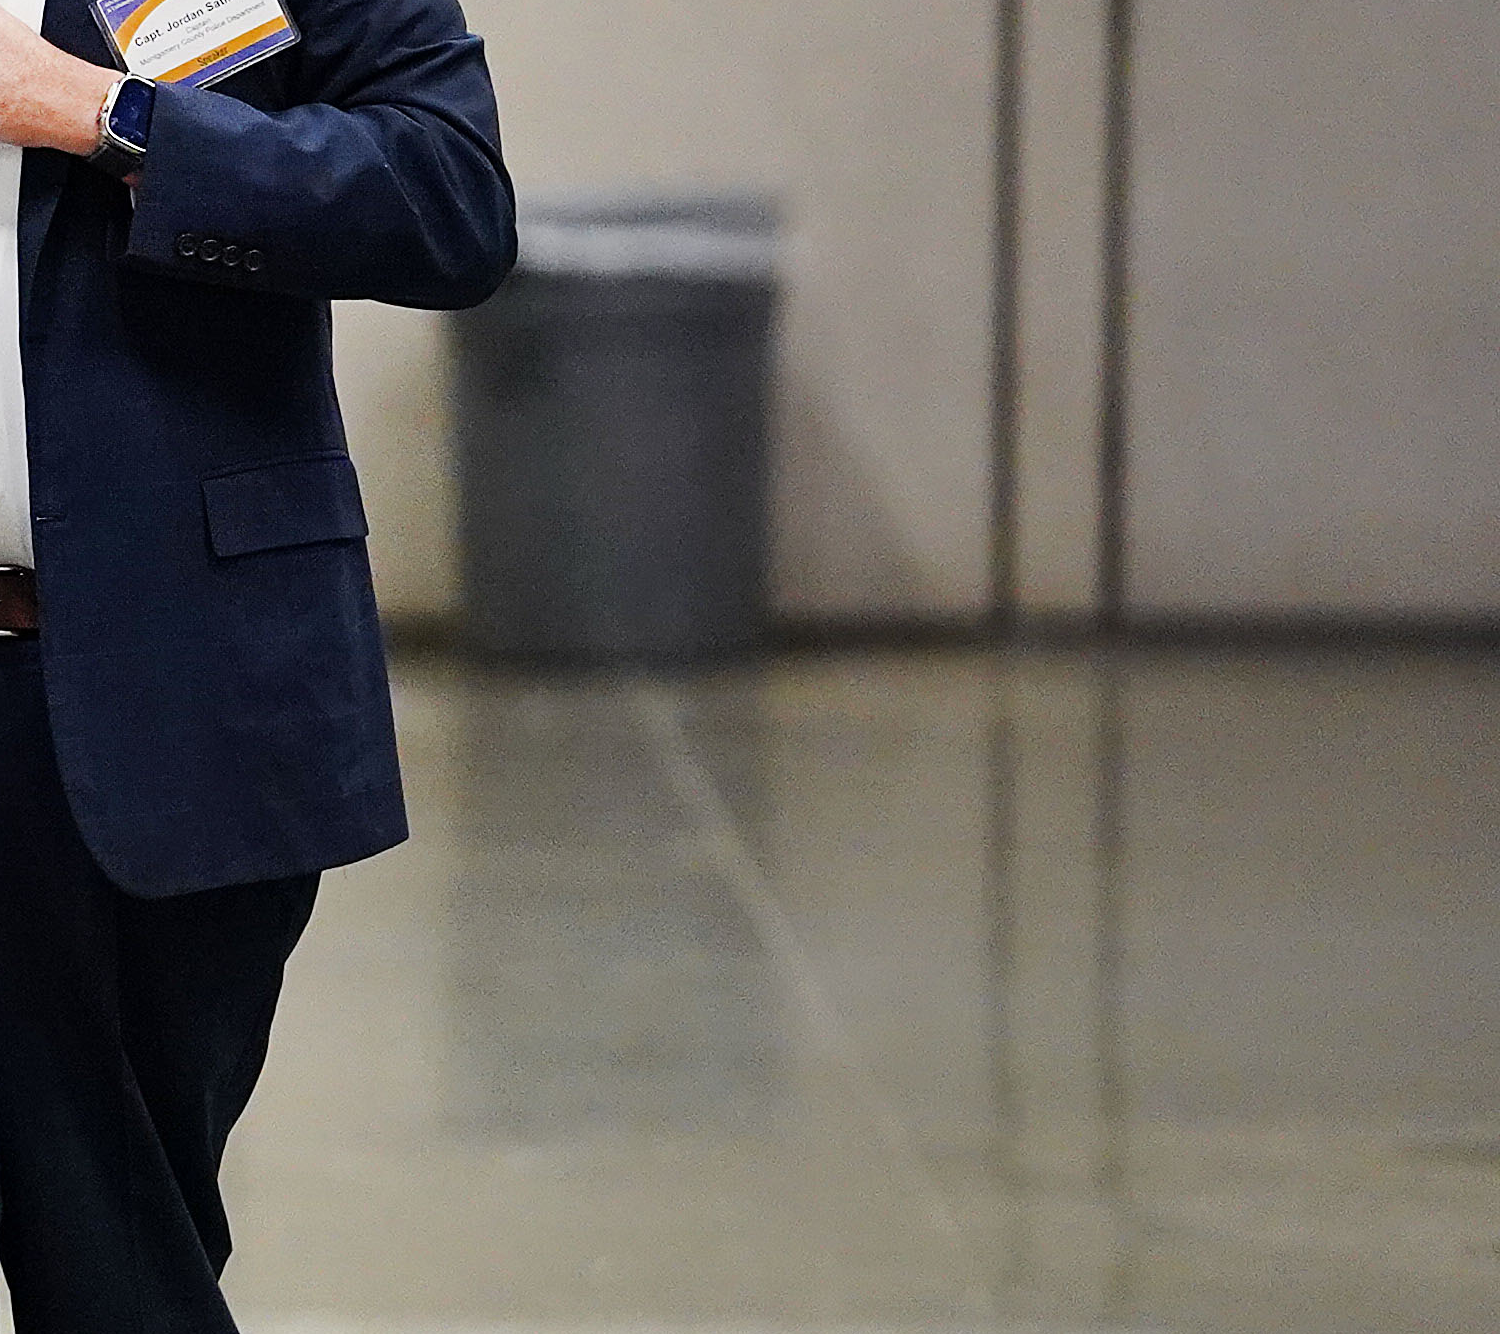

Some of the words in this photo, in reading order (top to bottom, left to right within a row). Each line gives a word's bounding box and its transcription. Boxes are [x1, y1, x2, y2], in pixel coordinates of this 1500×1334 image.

[134, 29, 164, 47] Capt.
[167, 7, 204, 32] Jordan
[226, 0, 266, 24] Department
